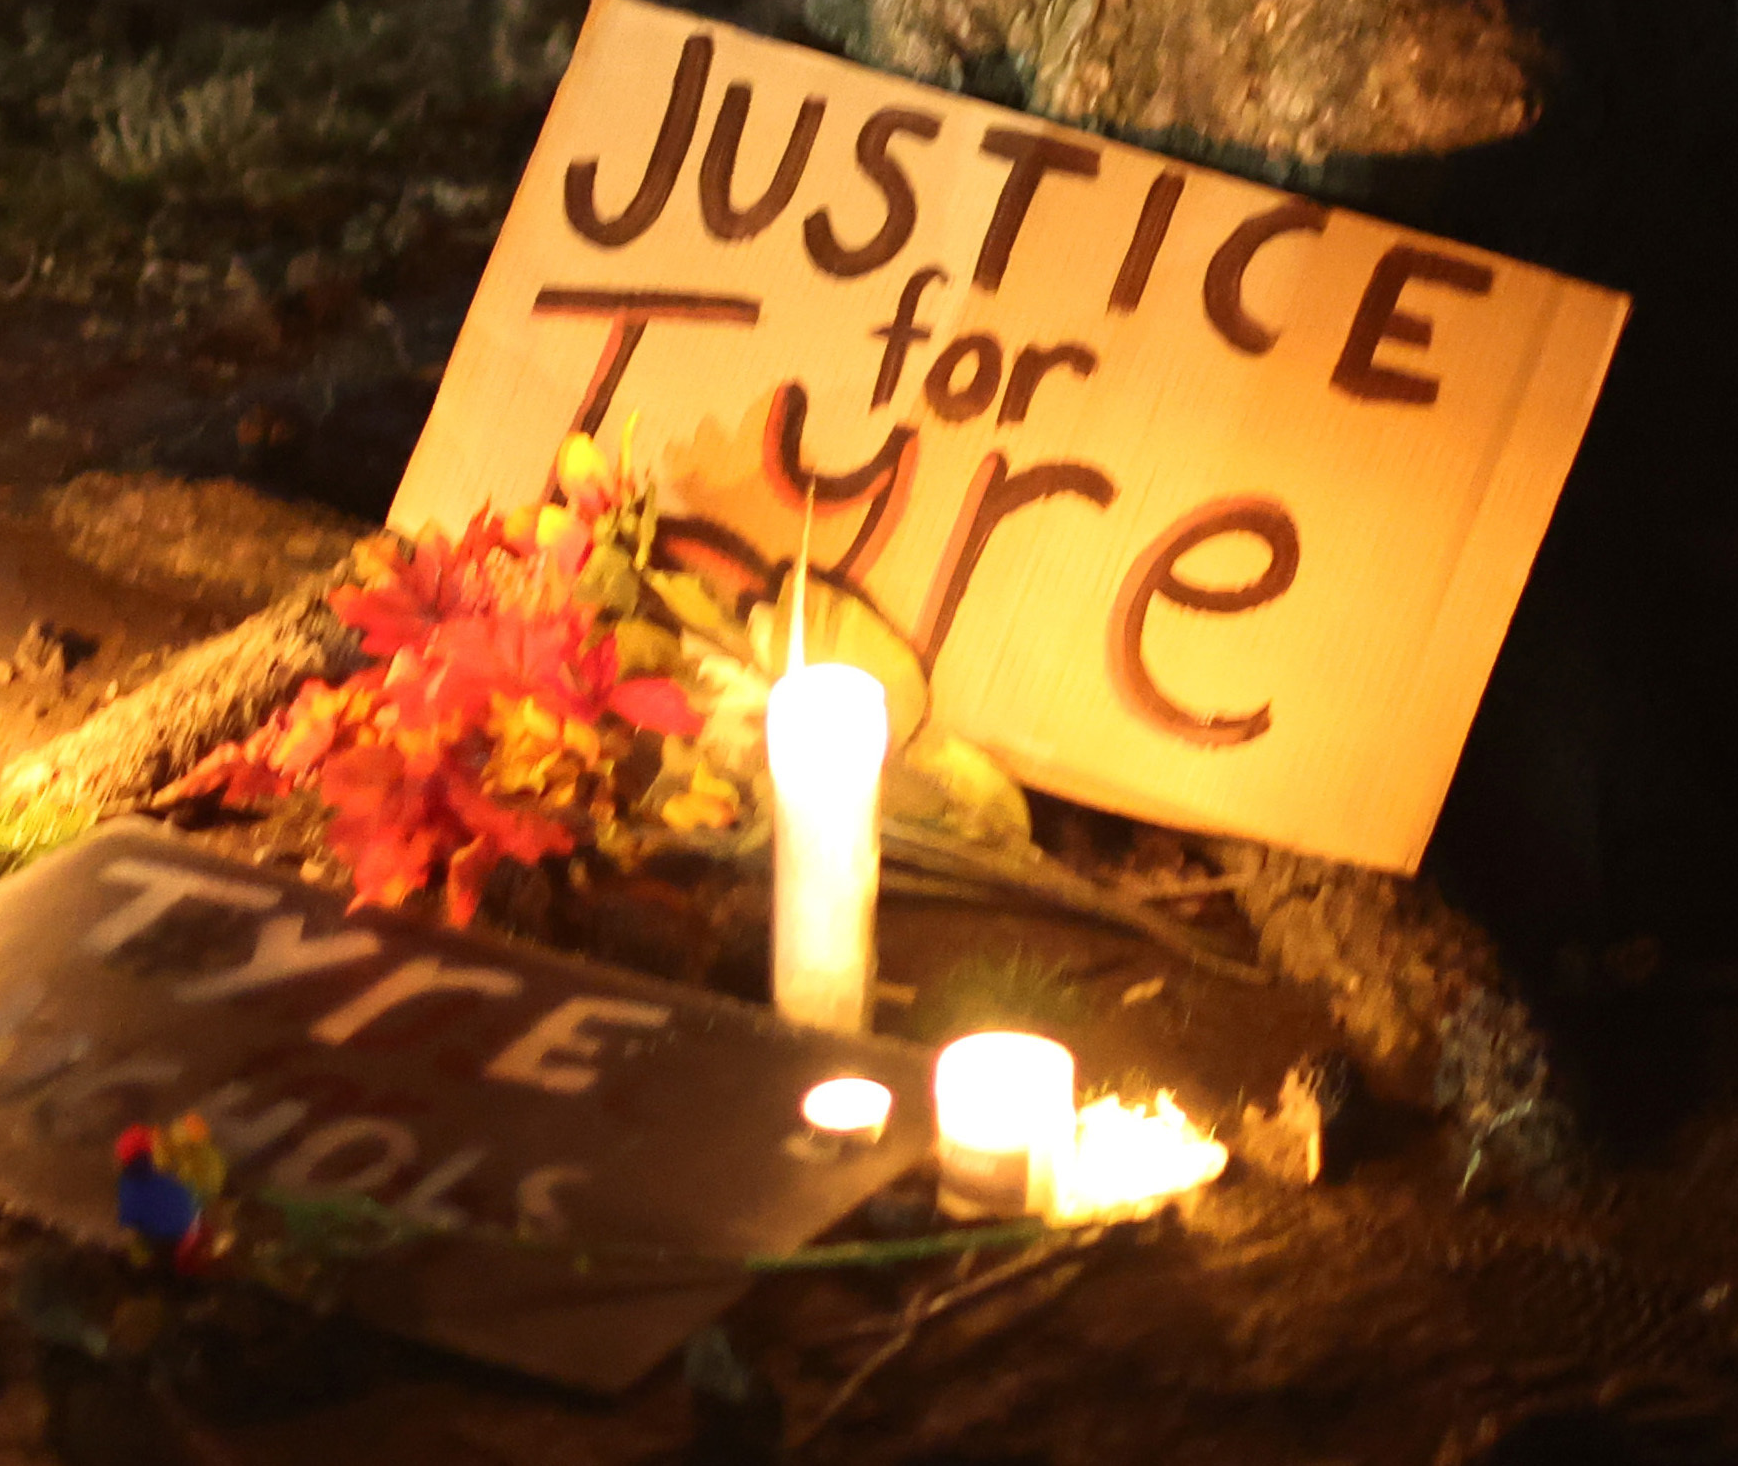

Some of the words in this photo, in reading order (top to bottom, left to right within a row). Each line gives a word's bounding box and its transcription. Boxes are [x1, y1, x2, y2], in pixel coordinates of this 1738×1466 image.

[564, 34, 1494, 406] JUSTICE
[869, 265, 1098, 426] for
[531, 284, 1301, 748] Tyre
